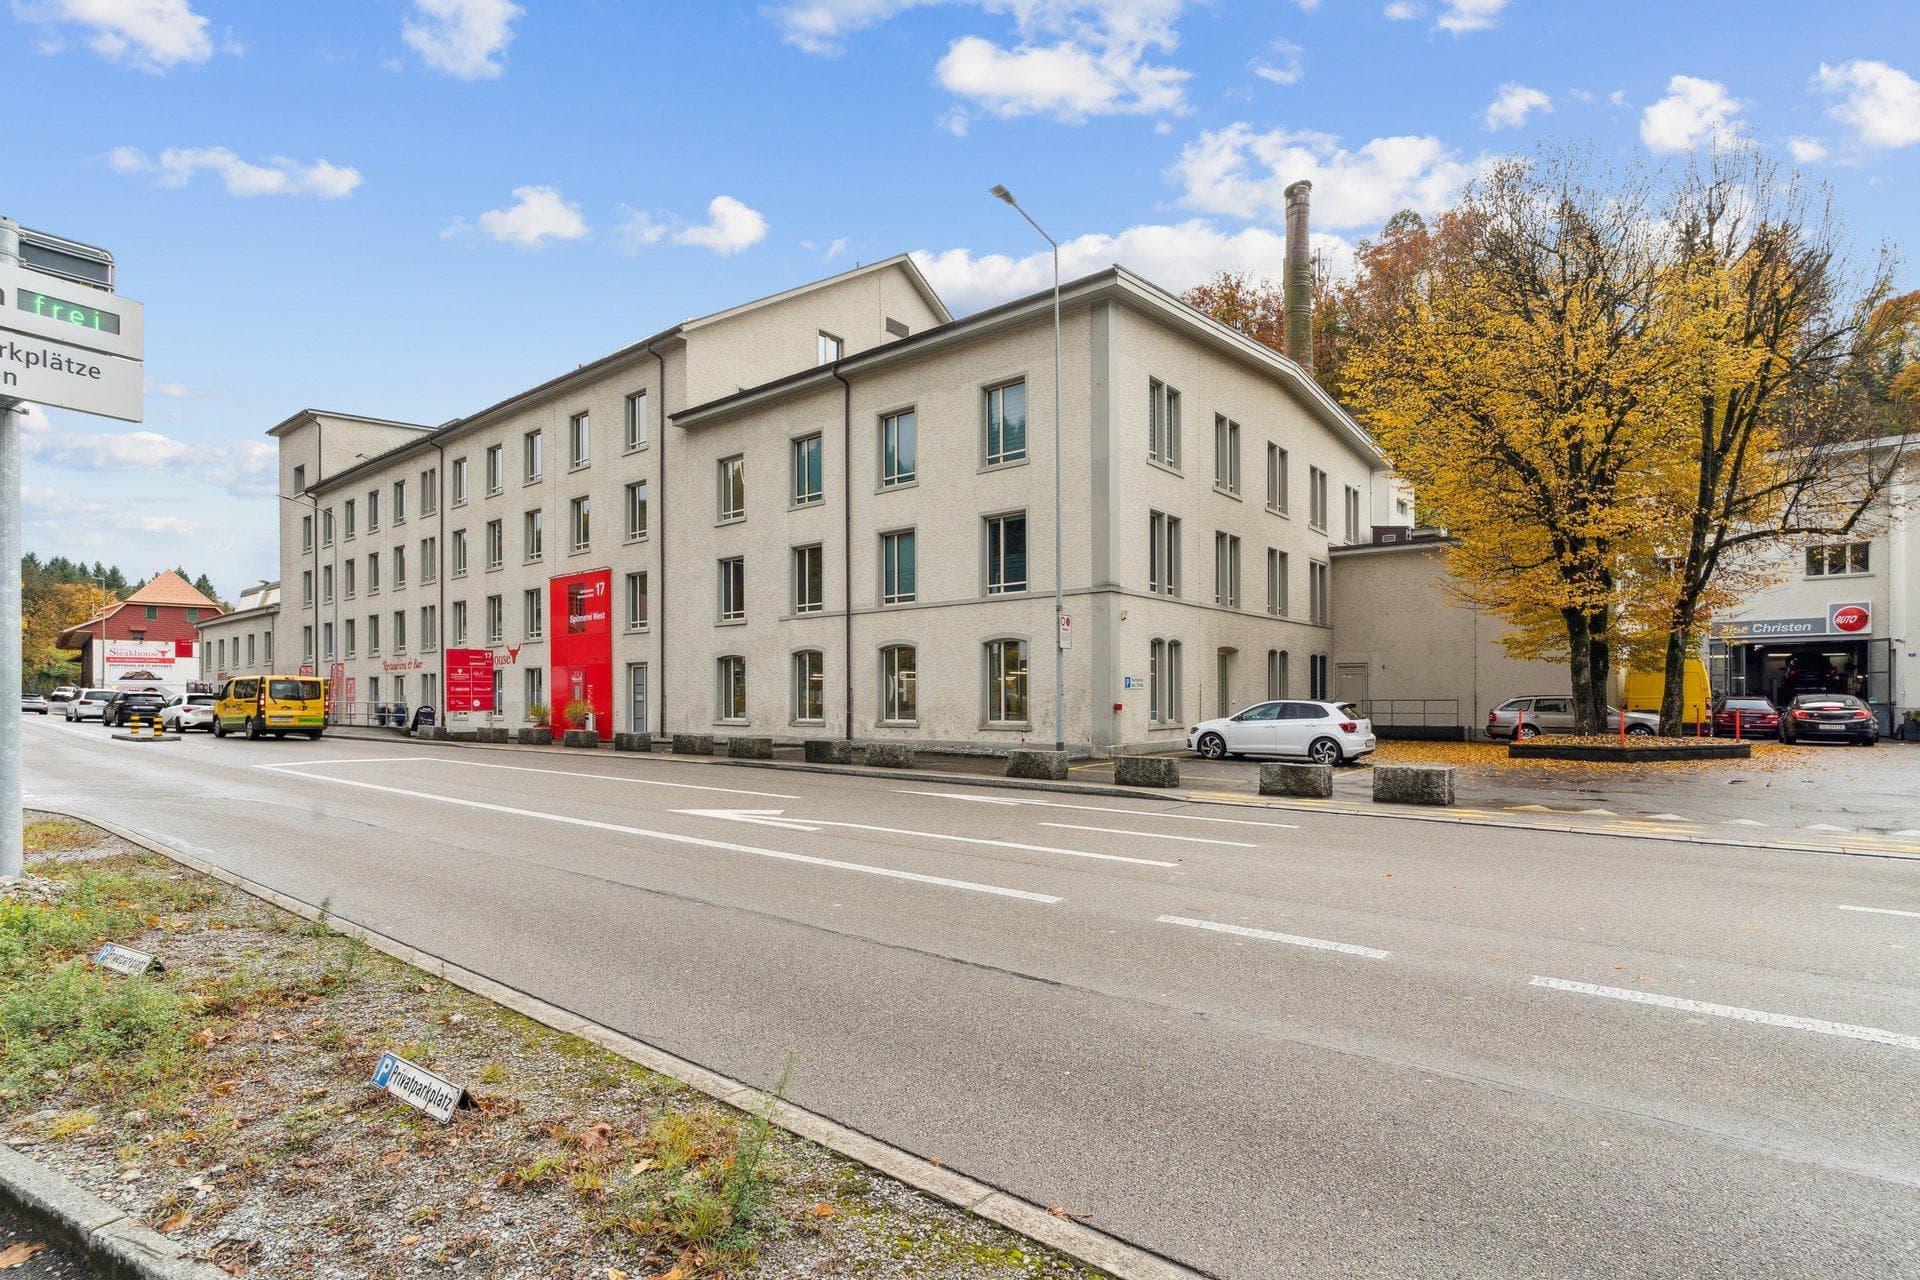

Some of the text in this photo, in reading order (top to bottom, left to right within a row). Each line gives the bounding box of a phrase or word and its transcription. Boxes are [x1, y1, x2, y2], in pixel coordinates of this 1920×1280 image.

[35, 296, 100, 331] frei
[0, 342, 101, 379] rkplätze
[595, 582, 605, 596] 17
[570, 612, 605, 624] Spinnerei West
[1752, 623, 1812, 633] Christen
[109, 648, 159, 657] Steakhouse
[414, 659, 423, 669] Bar
[376, 1058, 454, 1111] P Privatparkplatz
